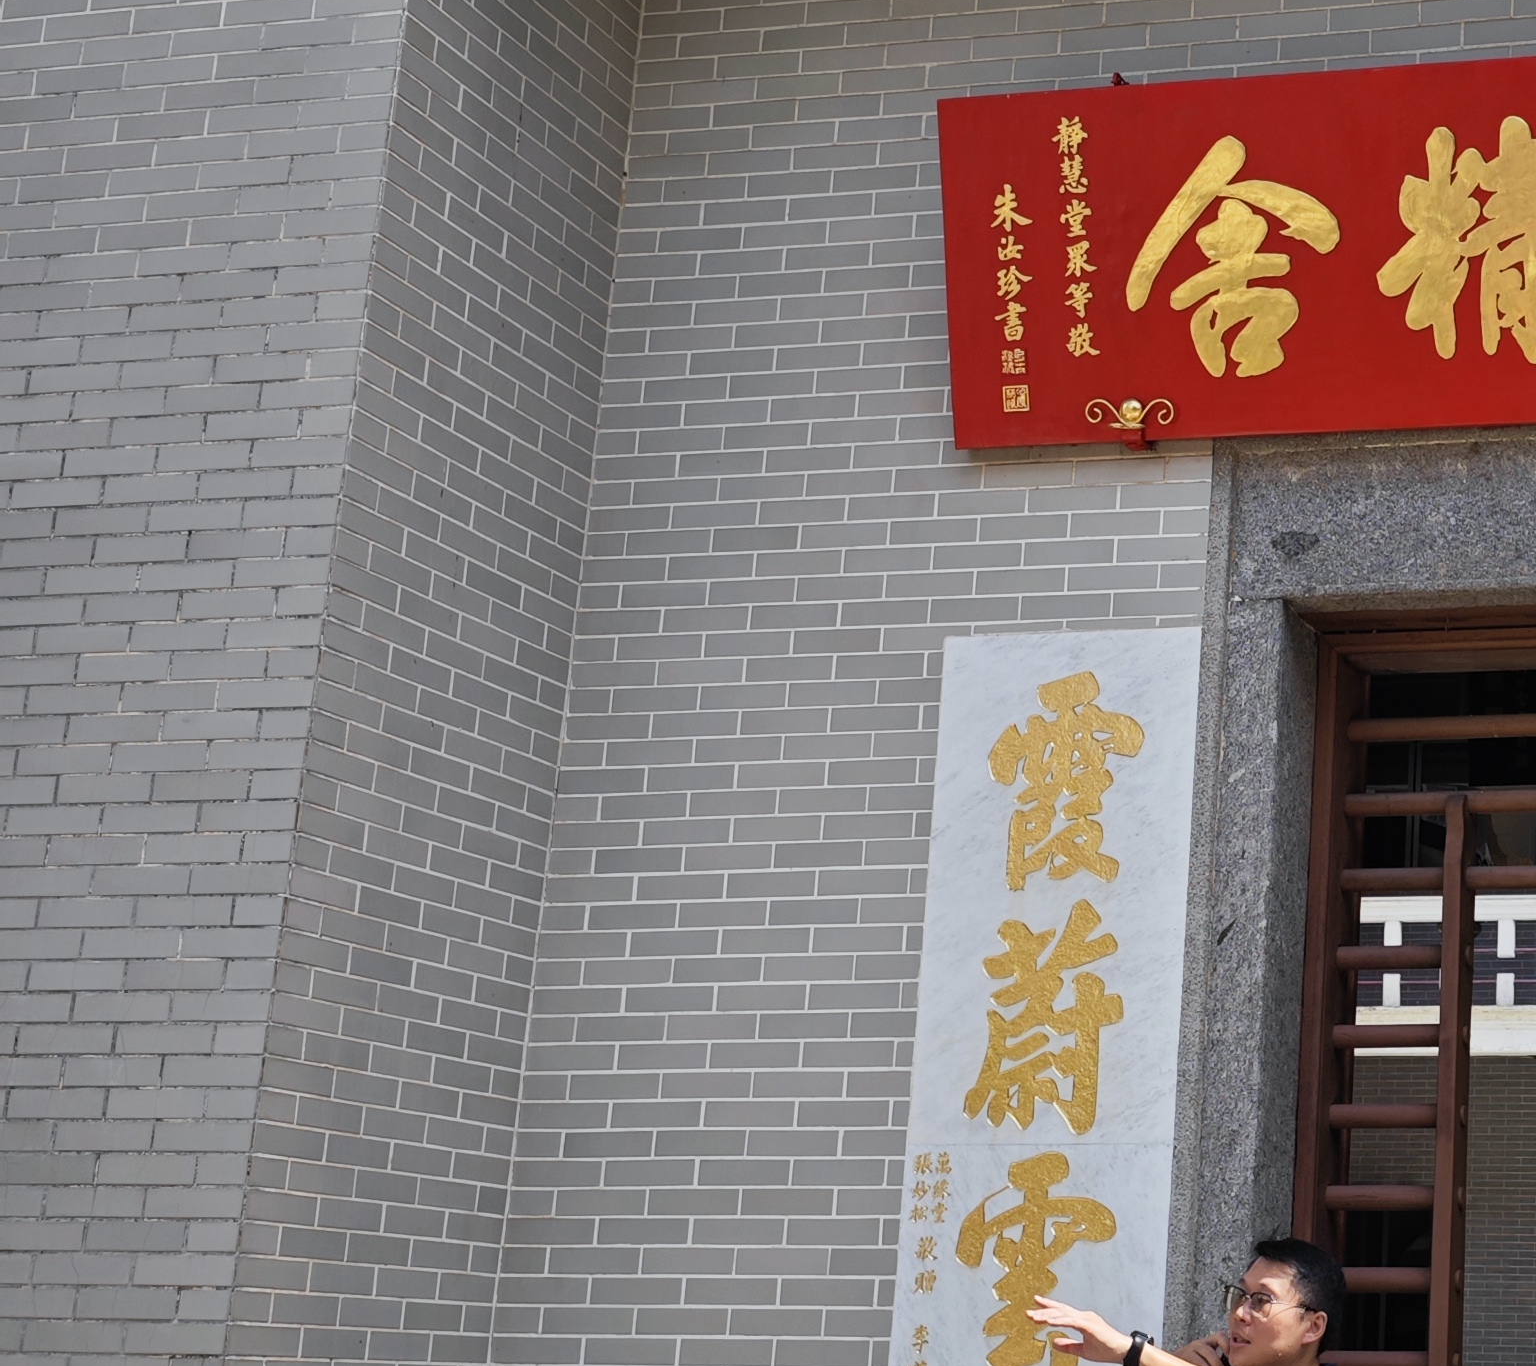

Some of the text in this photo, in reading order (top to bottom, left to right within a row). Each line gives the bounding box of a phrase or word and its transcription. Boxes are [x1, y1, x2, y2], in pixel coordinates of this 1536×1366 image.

[990, 183, 1034, 342] 朱汝珍書
[913, 1235, 938, 1295] 敬贈
